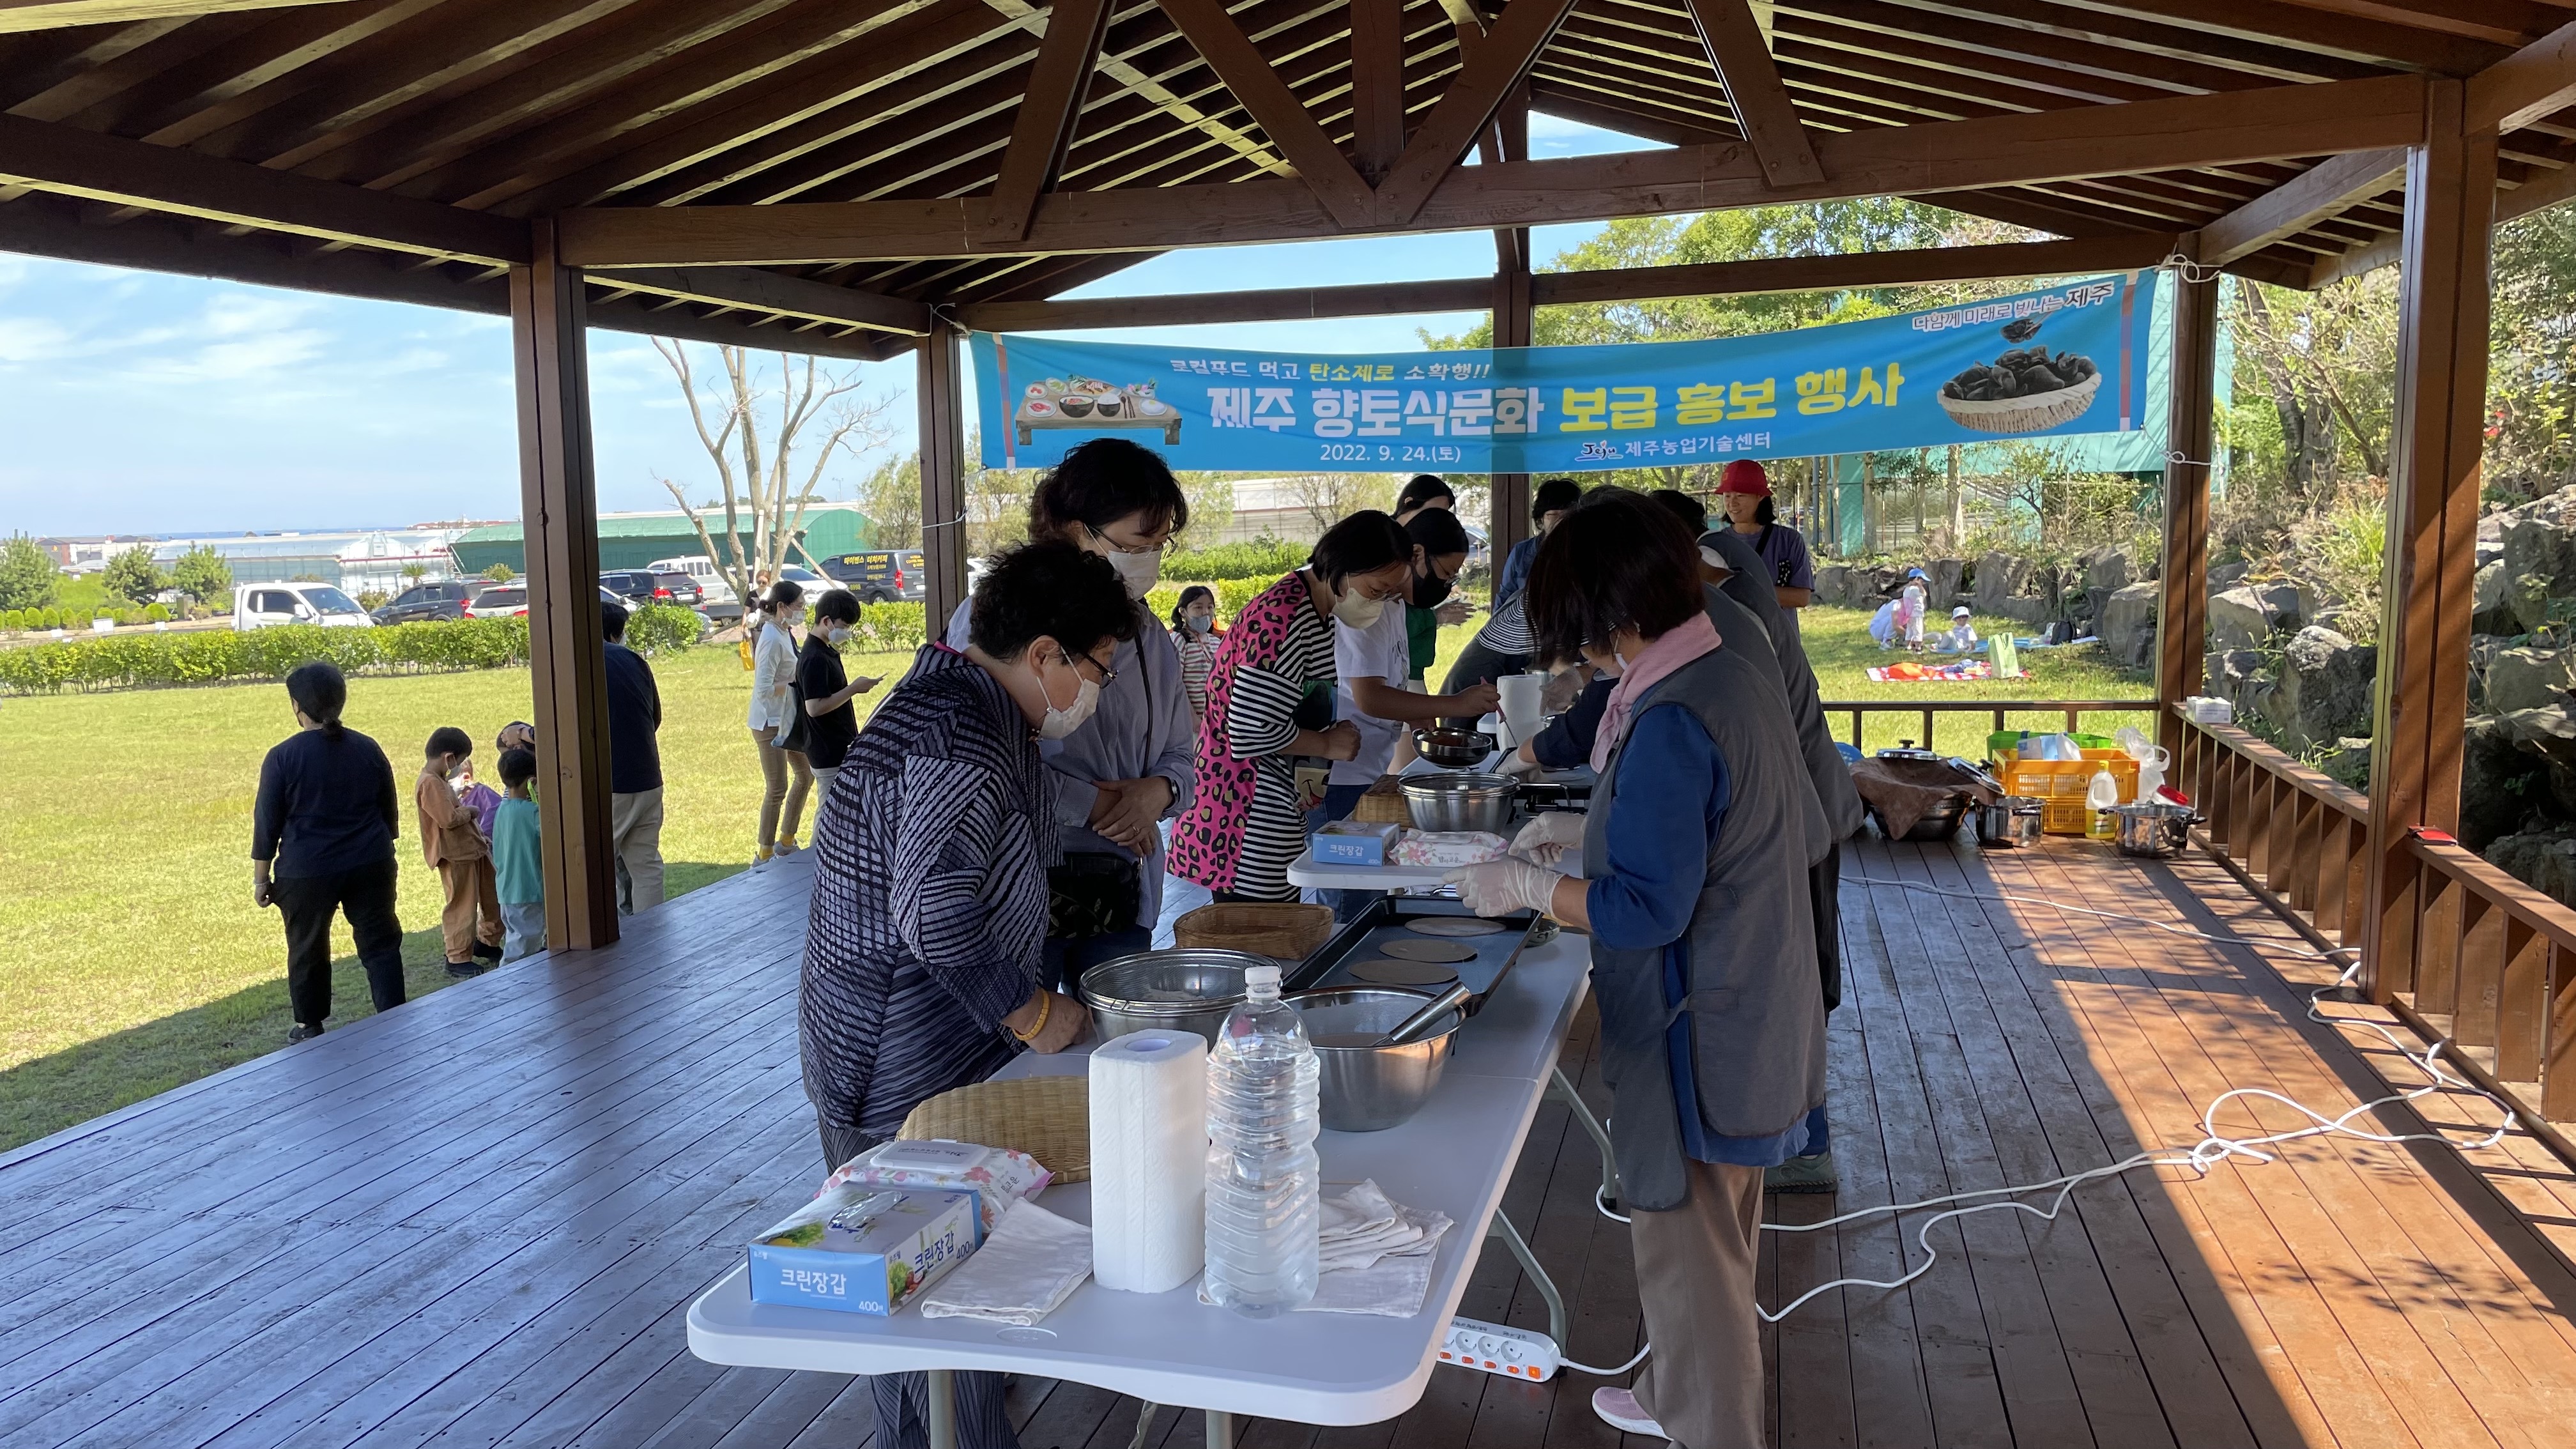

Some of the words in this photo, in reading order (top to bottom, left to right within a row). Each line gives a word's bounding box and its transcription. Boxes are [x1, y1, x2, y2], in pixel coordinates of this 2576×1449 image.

[1913, 311, 1961, 330] 다함께
[1965, 304, 2011, 323] 미래로
[2015, 296, 2063, 318] 빛나는
[2064, 283, 2113, 307] 제주
[1170, 360, 1252, 377] 로컬푸드
[1259, 362, 1301, 379] 먹고
[1309, 363, 1395, 382] 탄소제로
[1404, 363, 1491, 381] 소확행!!
[1207, 388, 1296, 433] 제주
[1312, 387, 1545, 438] 향토식문화
[1560, 387, 1659, 432] 보급
[1676, 378, 1777, 425] 홍보
[1795, 362, 1905, 415] 행사
[1319, 444, 1370, 461] 2022.
[1378, 445, 1395, 461] 9.
[1402, 445, 1461, 463] 24.(토)
[1625, 431, 1770, 457] 제주농업기술센터
[1329, 844, 1364, 857] 크린장갑
[914, 1230, 954, 1275] 크린장갑
[780, 1269, 847, 1295] 크린장갑
